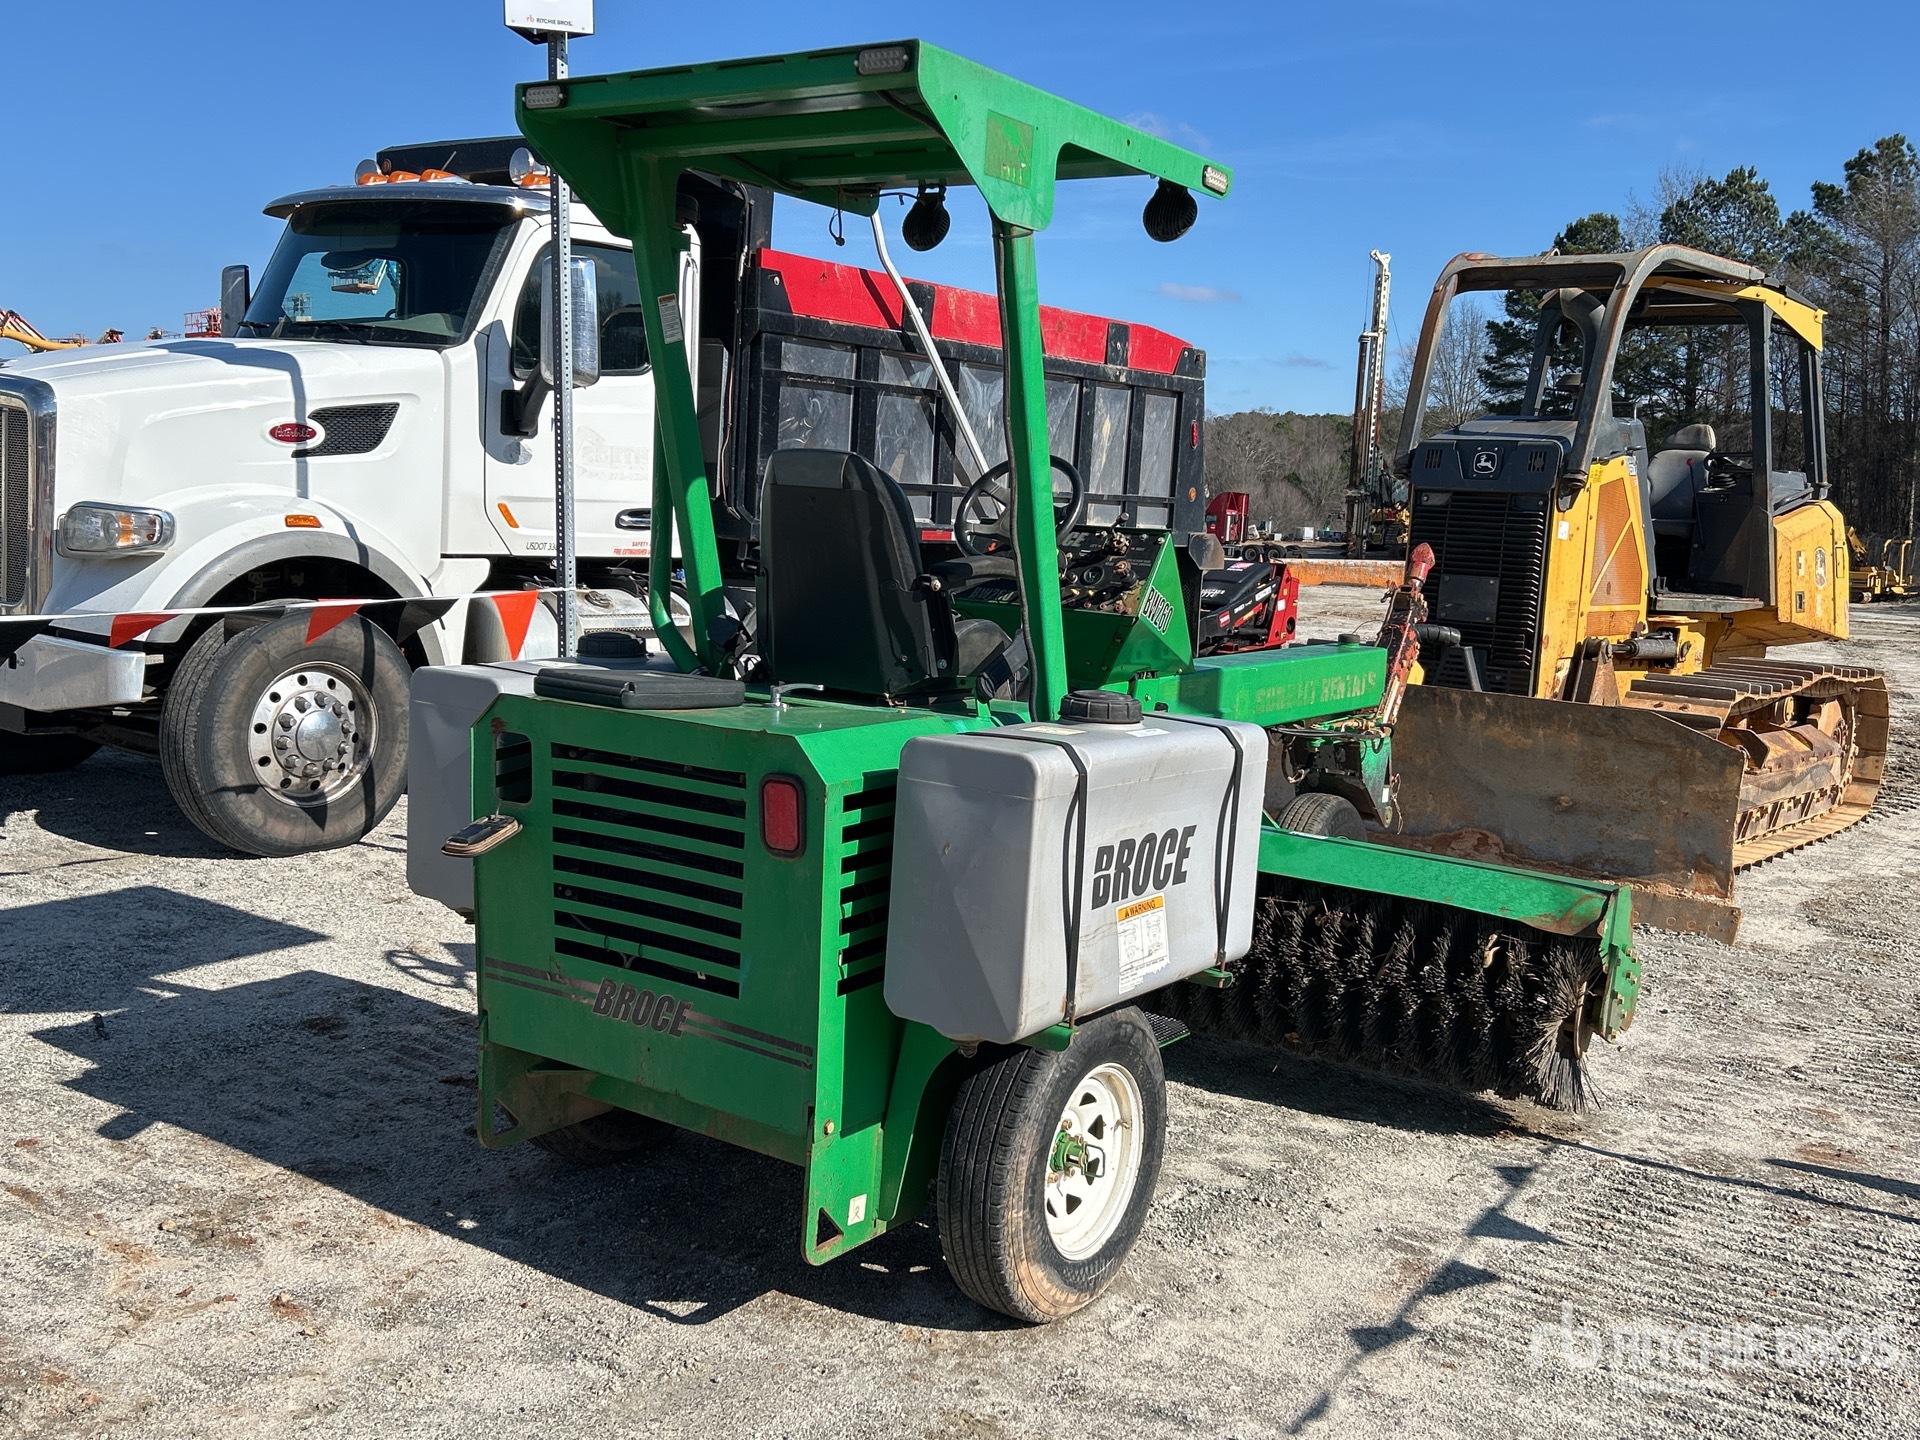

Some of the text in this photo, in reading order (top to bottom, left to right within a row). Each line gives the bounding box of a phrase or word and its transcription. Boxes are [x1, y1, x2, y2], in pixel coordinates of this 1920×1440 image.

[536, 17, 556, 25] RITCHIE
[526, 542, 547, 551] USDOT
[1141, 586, 1174, 635] BW260
[1091, 824, 1197, 910] BROCE
[1129, 899, 1156, 916] WARNING
[592, 977, 693, 1038] BROCE
